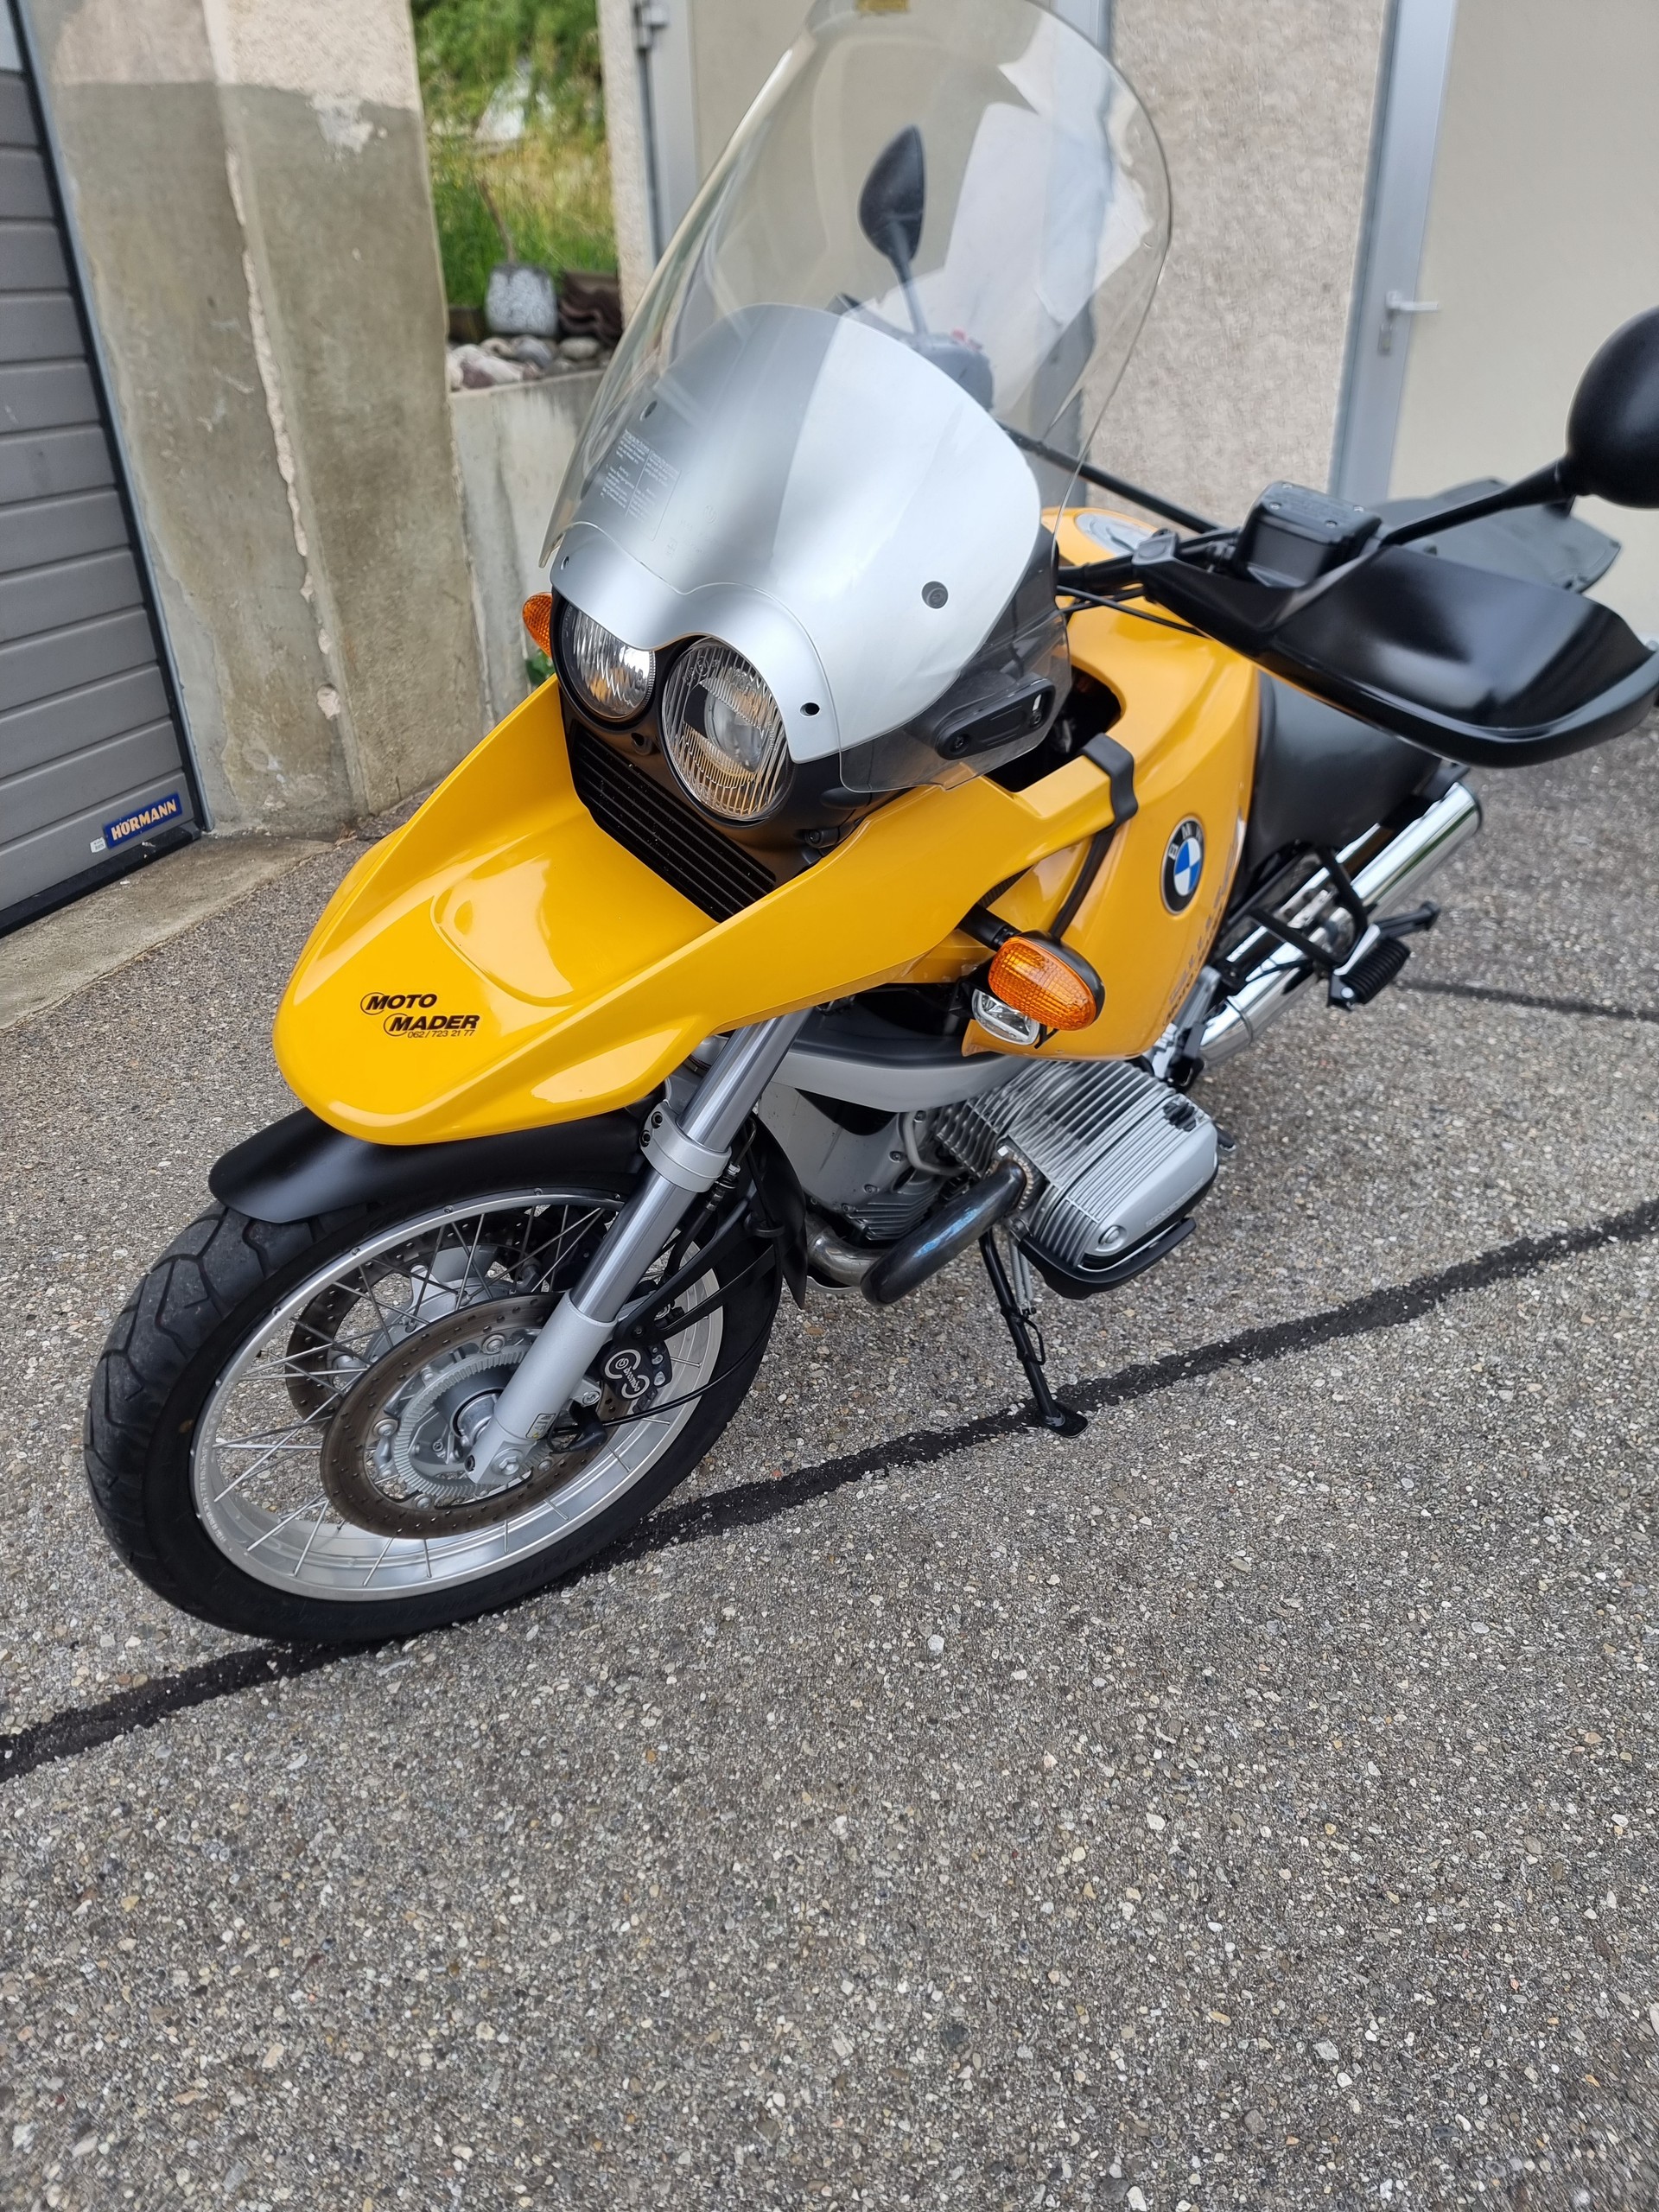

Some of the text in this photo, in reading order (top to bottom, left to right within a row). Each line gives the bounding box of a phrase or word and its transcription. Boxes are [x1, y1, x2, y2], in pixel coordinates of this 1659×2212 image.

[365, 994, 437, 1011] MOTO
[388, 1014, 480, 1032] MADER
[623, 1365, 640, 1392] brembo
